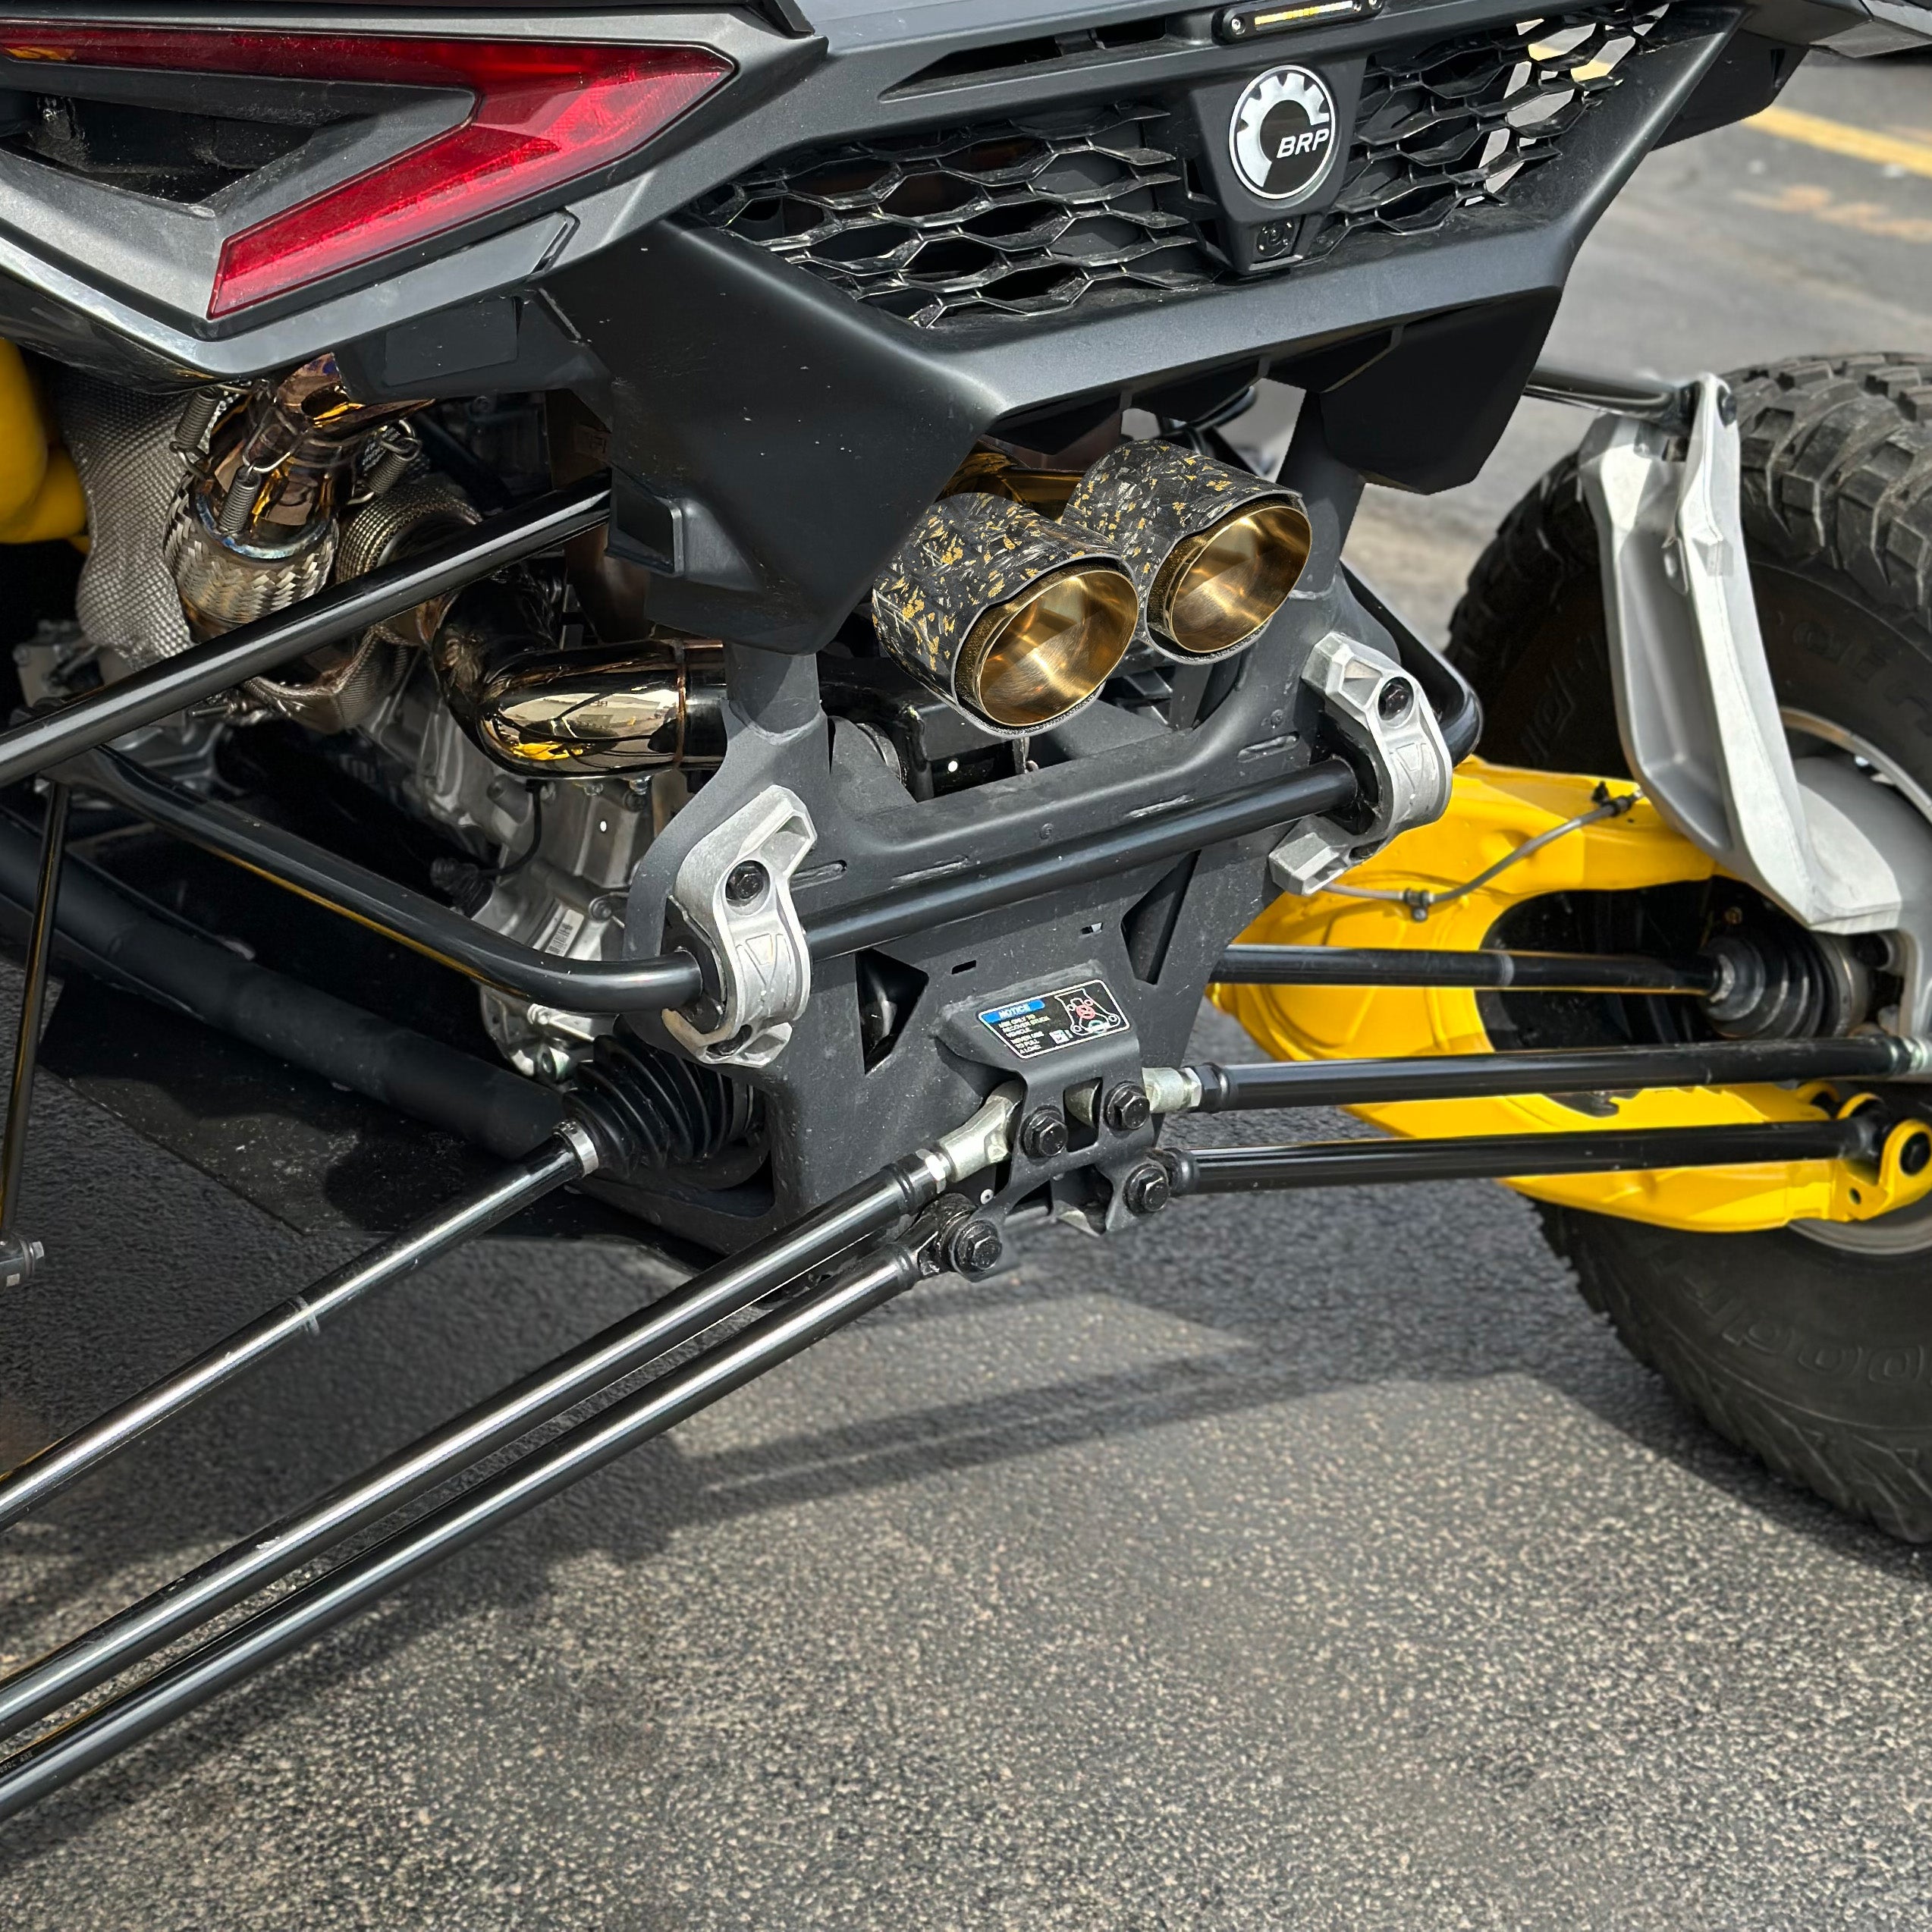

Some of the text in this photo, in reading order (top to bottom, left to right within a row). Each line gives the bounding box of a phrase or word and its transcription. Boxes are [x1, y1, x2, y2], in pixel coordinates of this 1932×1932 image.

[1277, 128, 1329, 159] BRP
[998, 1004, 1029, 1019] NOTICE
[1002, 1016, 1051, 1032] RECOVER STUCK
[1010, 1035, 1032, 1044] NEVER
[1023, 1038, 1040, 1047] PULL
